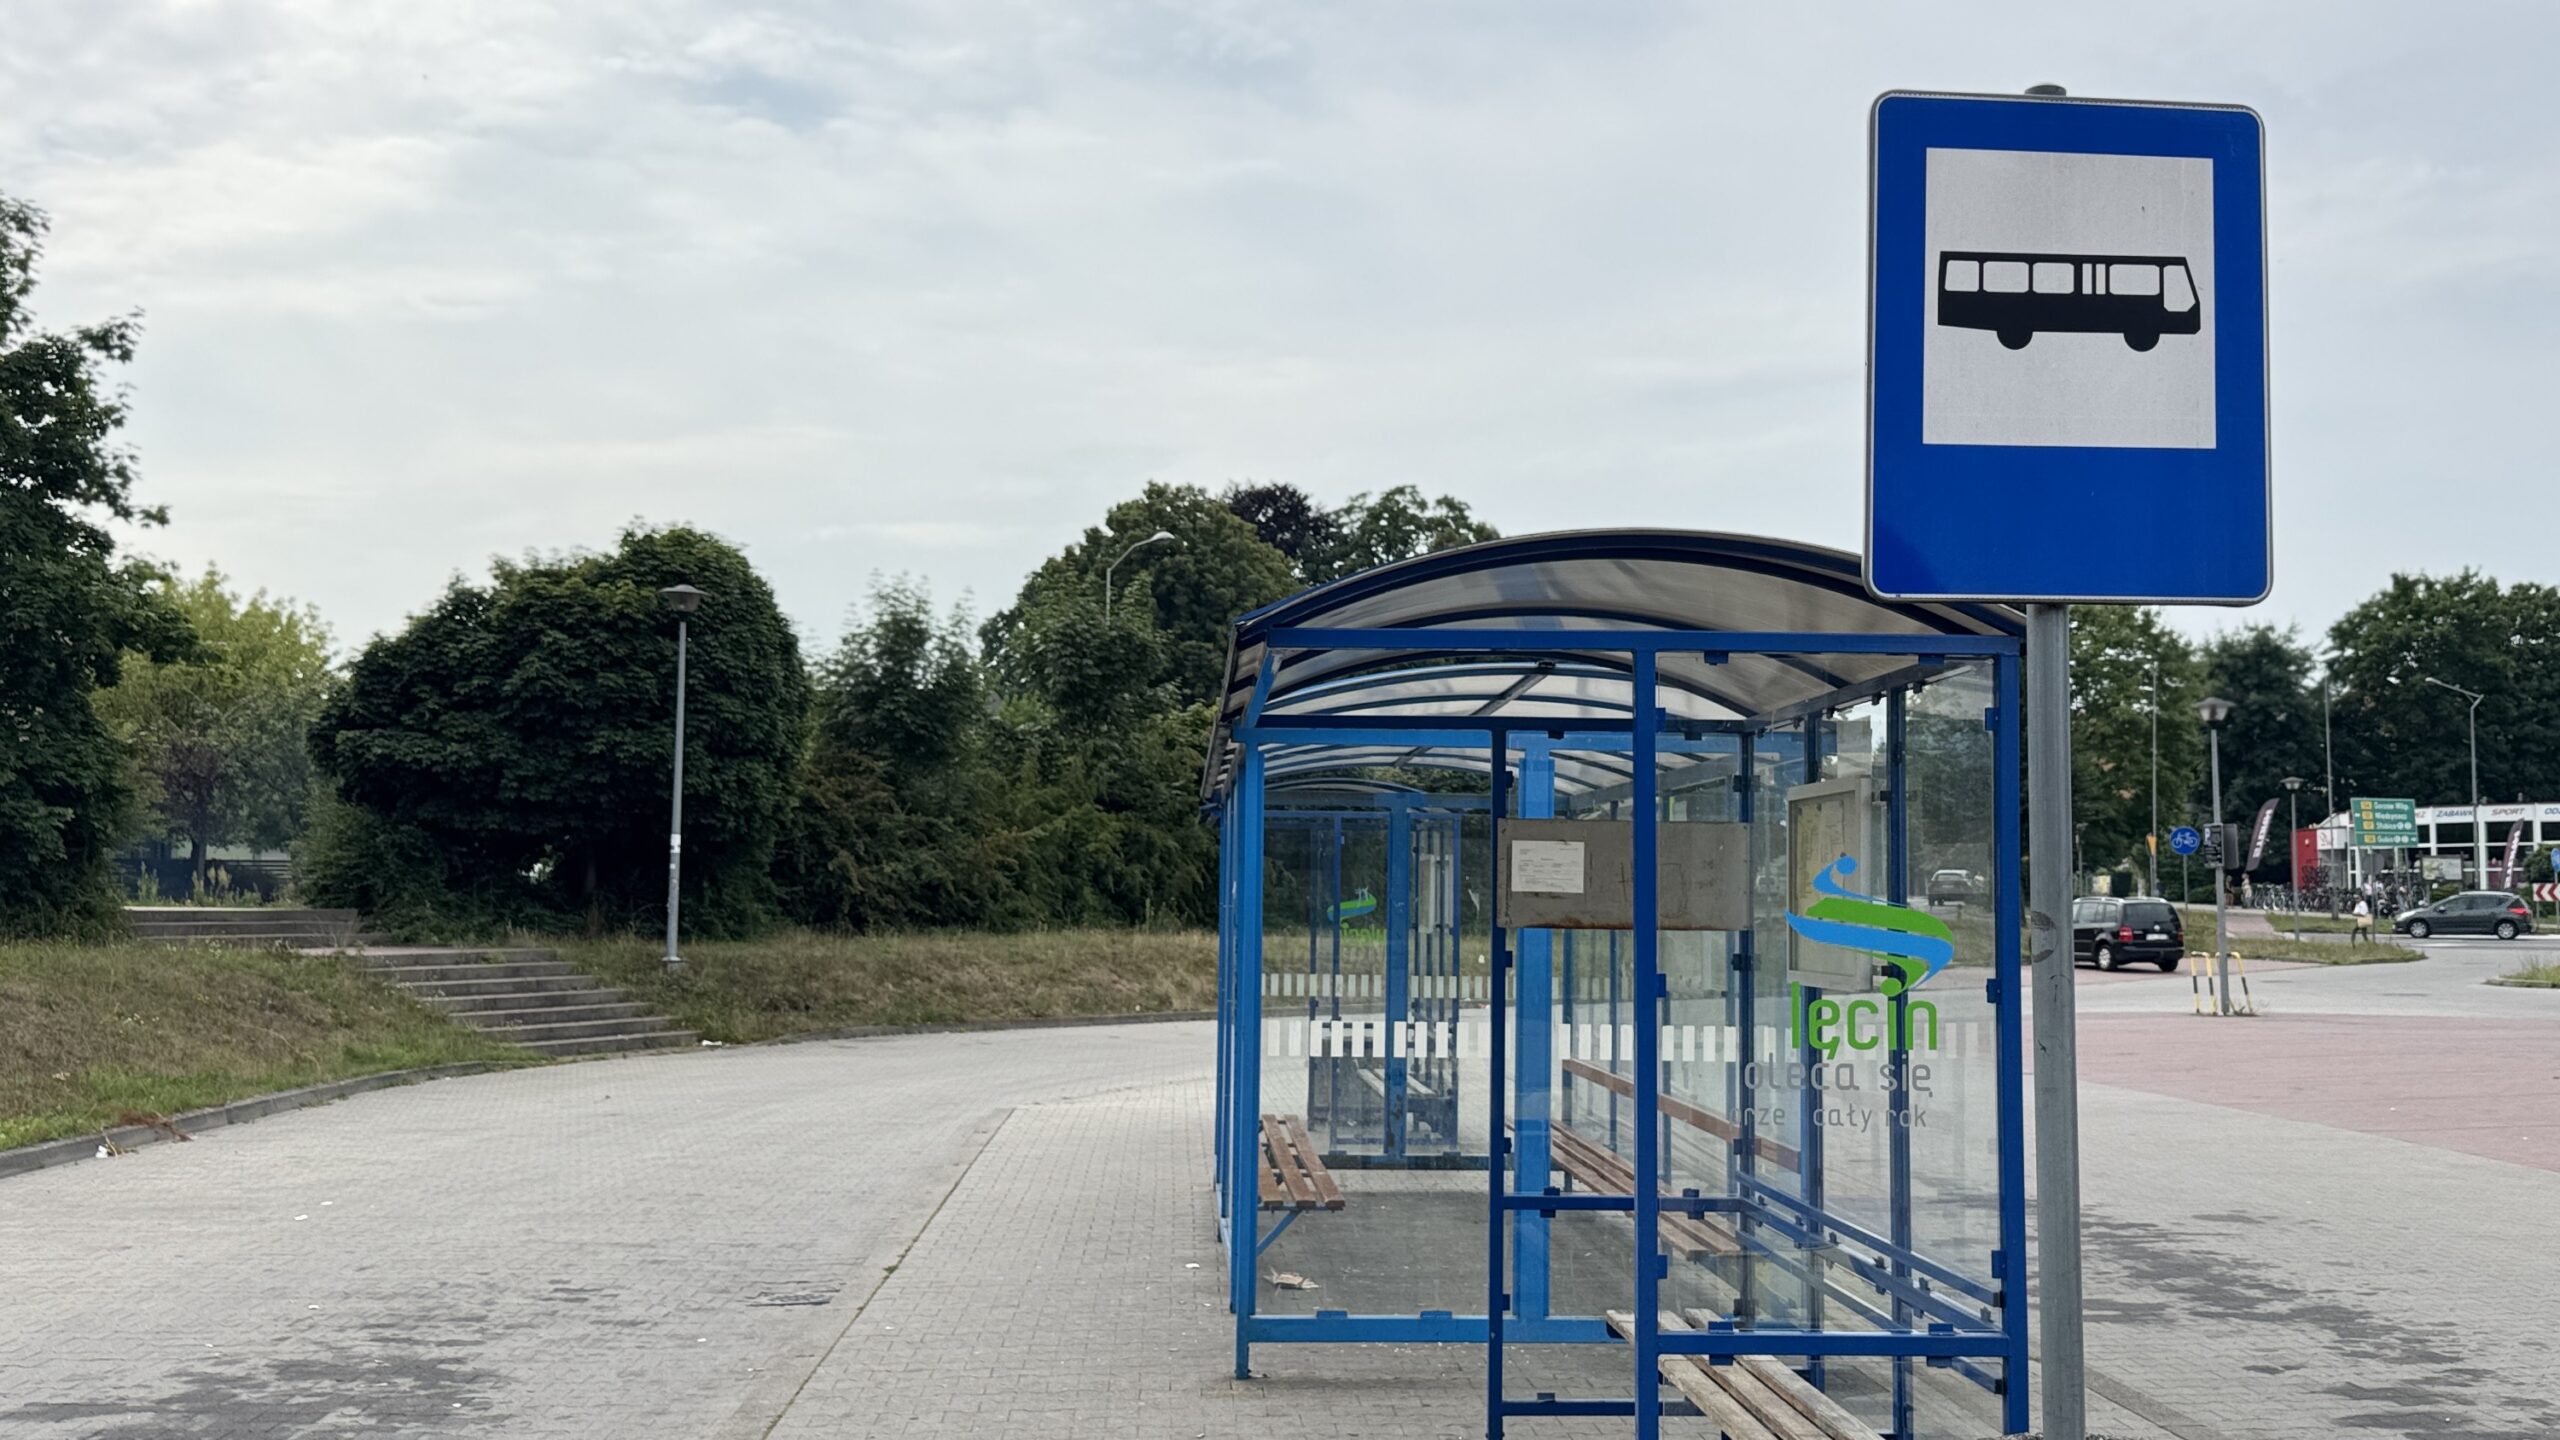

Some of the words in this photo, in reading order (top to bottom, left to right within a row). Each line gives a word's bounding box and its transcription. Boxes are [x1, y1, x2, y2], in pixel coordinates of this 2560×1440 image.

[2436, 809, 2474, 818] ZABAWK
[2491, 807, 2525, 816] SPORT
[1879, 1054, 1934, 1098] się
[1813, 1103, 1873, 1133] cały
[1886, 1103, 1927, 1128] rok
